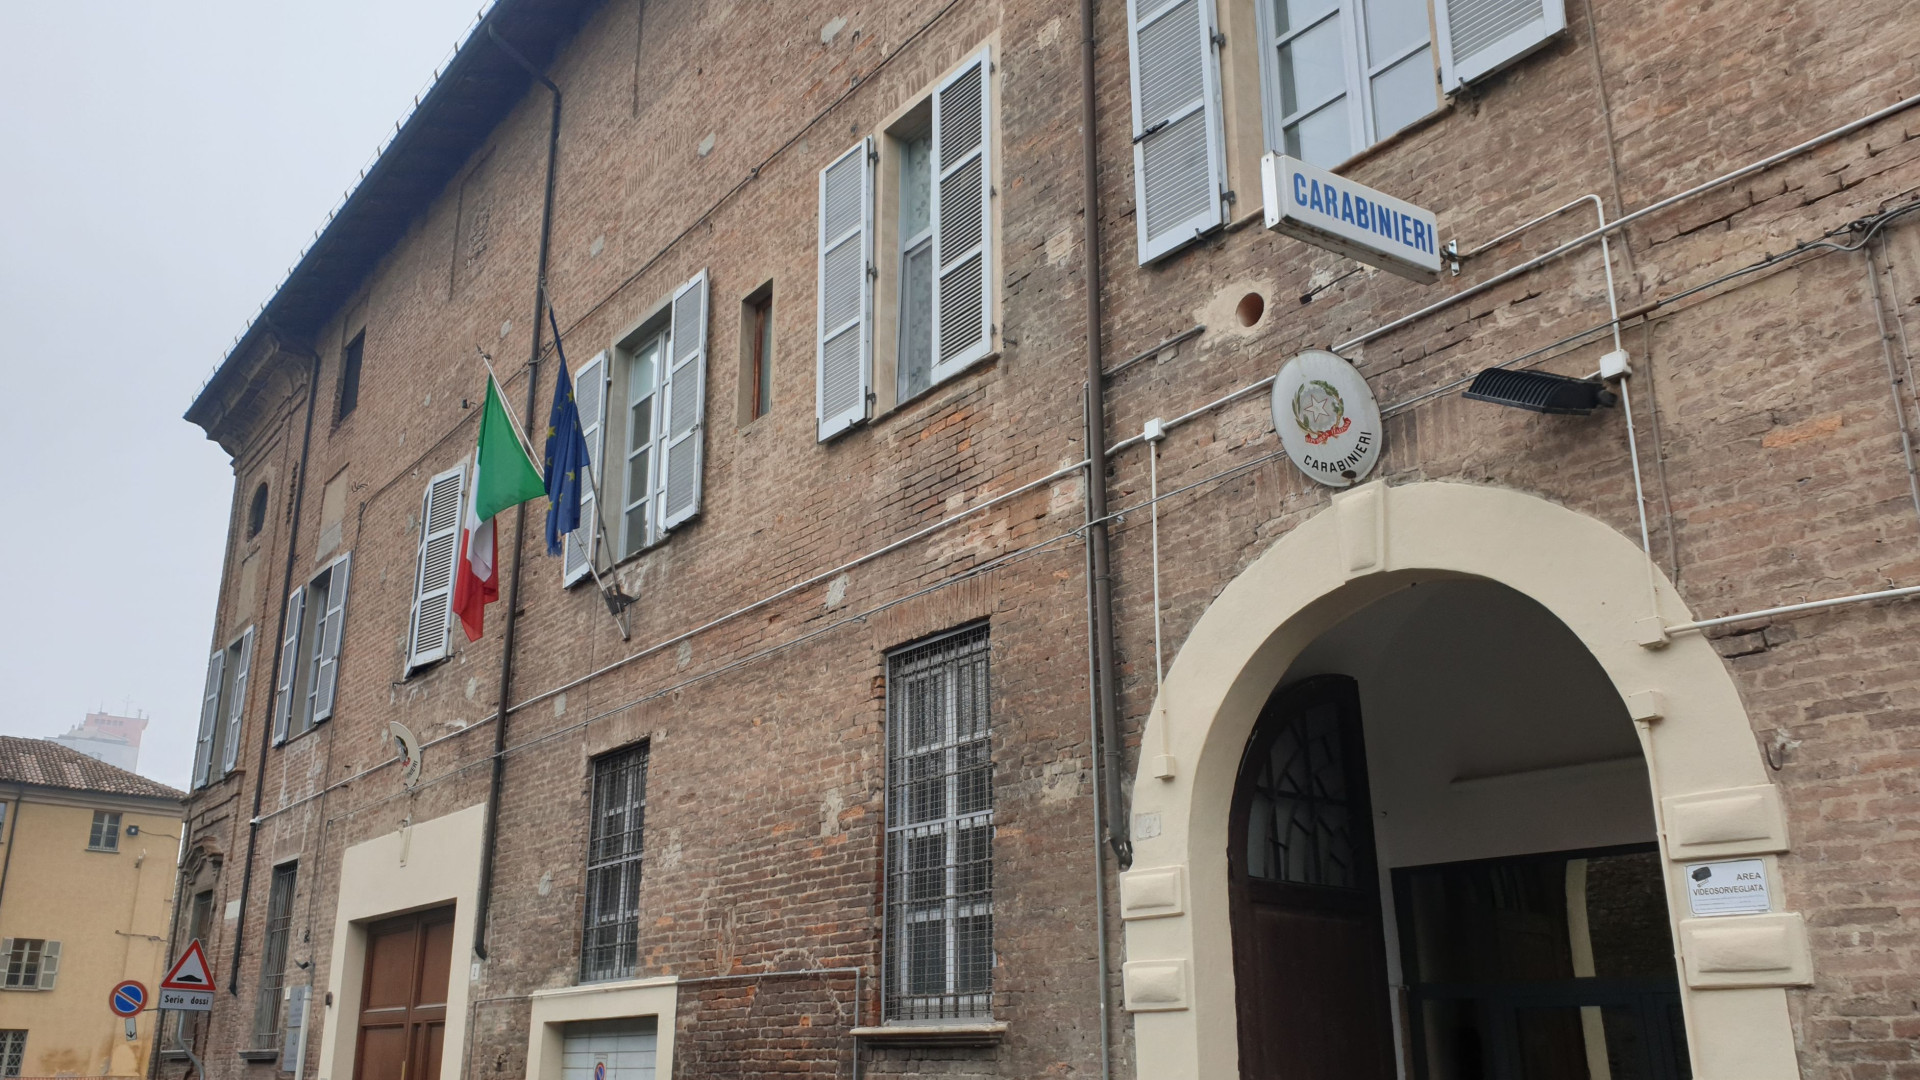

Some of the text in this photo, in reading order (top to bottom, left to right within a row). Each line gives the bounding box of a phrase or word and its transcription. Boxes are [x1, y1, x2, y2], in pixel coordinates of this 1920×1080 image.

[1293, 172, 1434, 255] CARABINIERI
[1303, 431, 1372, 473] CARABINIERI
[1736, 872, 1762, 881] AREA
[1693, 884, 1764, 896] VIDEOSORVEGLIATA
[164, 994, 209, 1005] Serie dossi
